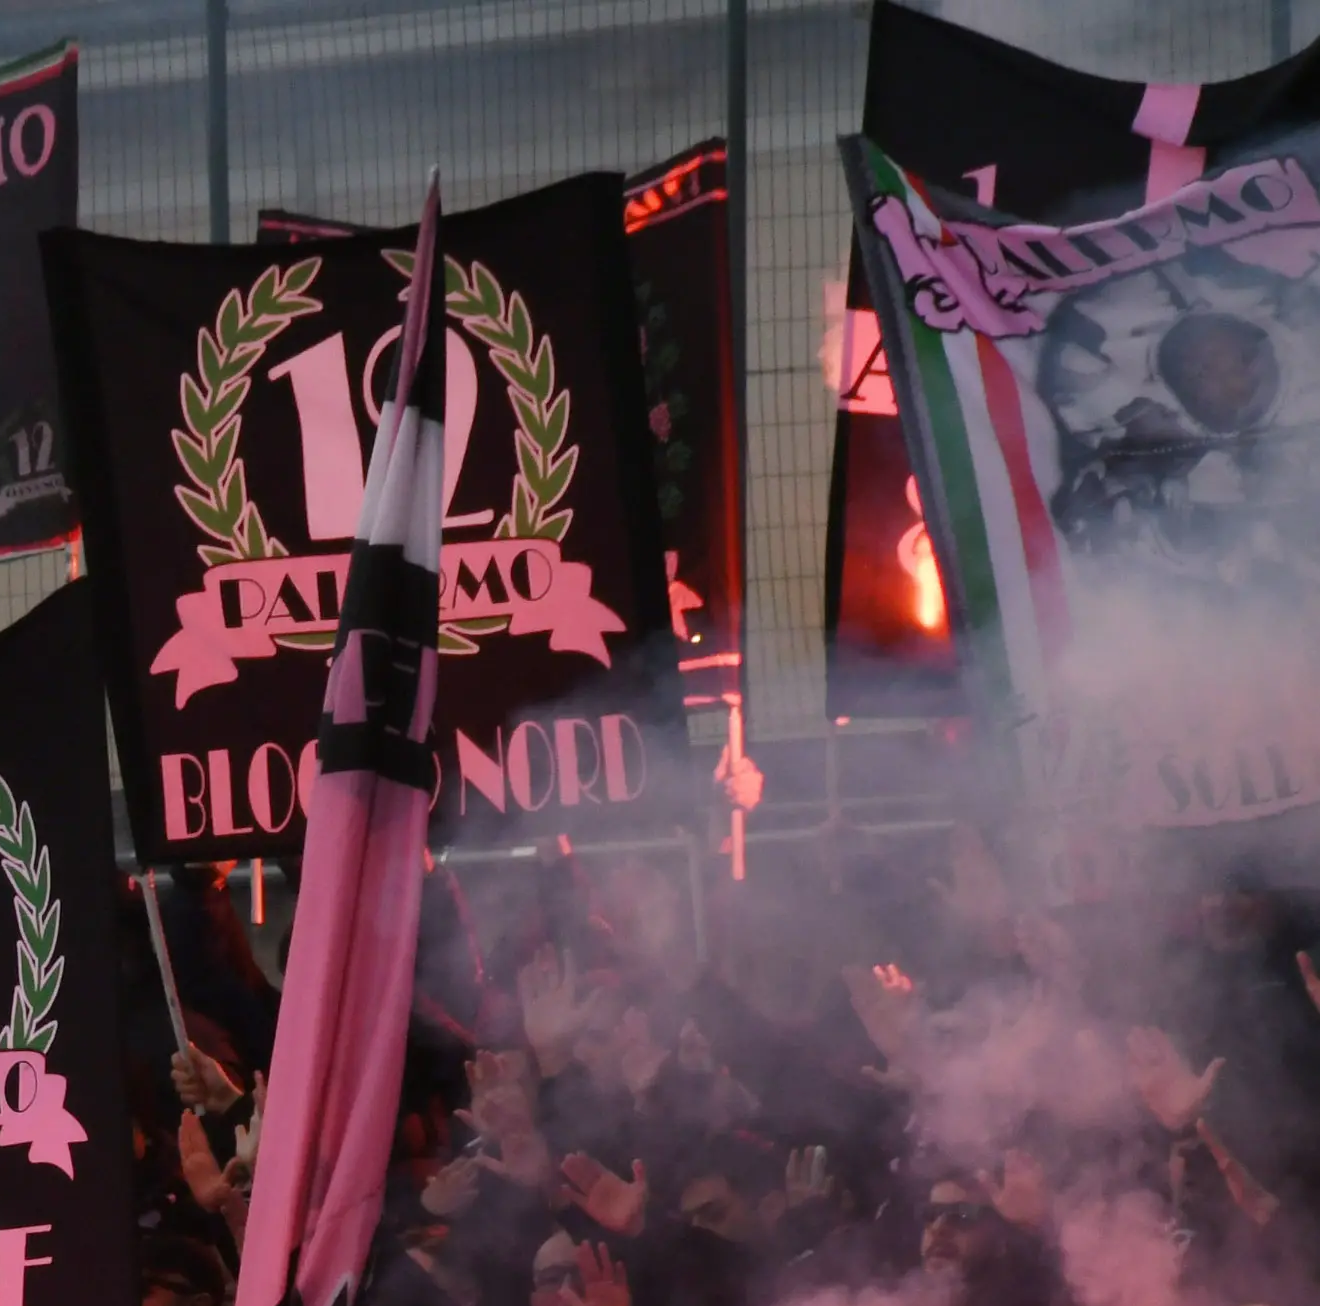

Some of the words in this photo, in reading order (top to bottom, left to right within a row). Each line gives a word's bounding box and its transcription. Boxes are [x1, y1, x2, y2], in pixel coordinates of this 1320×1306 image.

[9, 420, 56, 476] 12
[219, 548, 552, 630] PALMO
[456, 713, 647, 815] NORD
